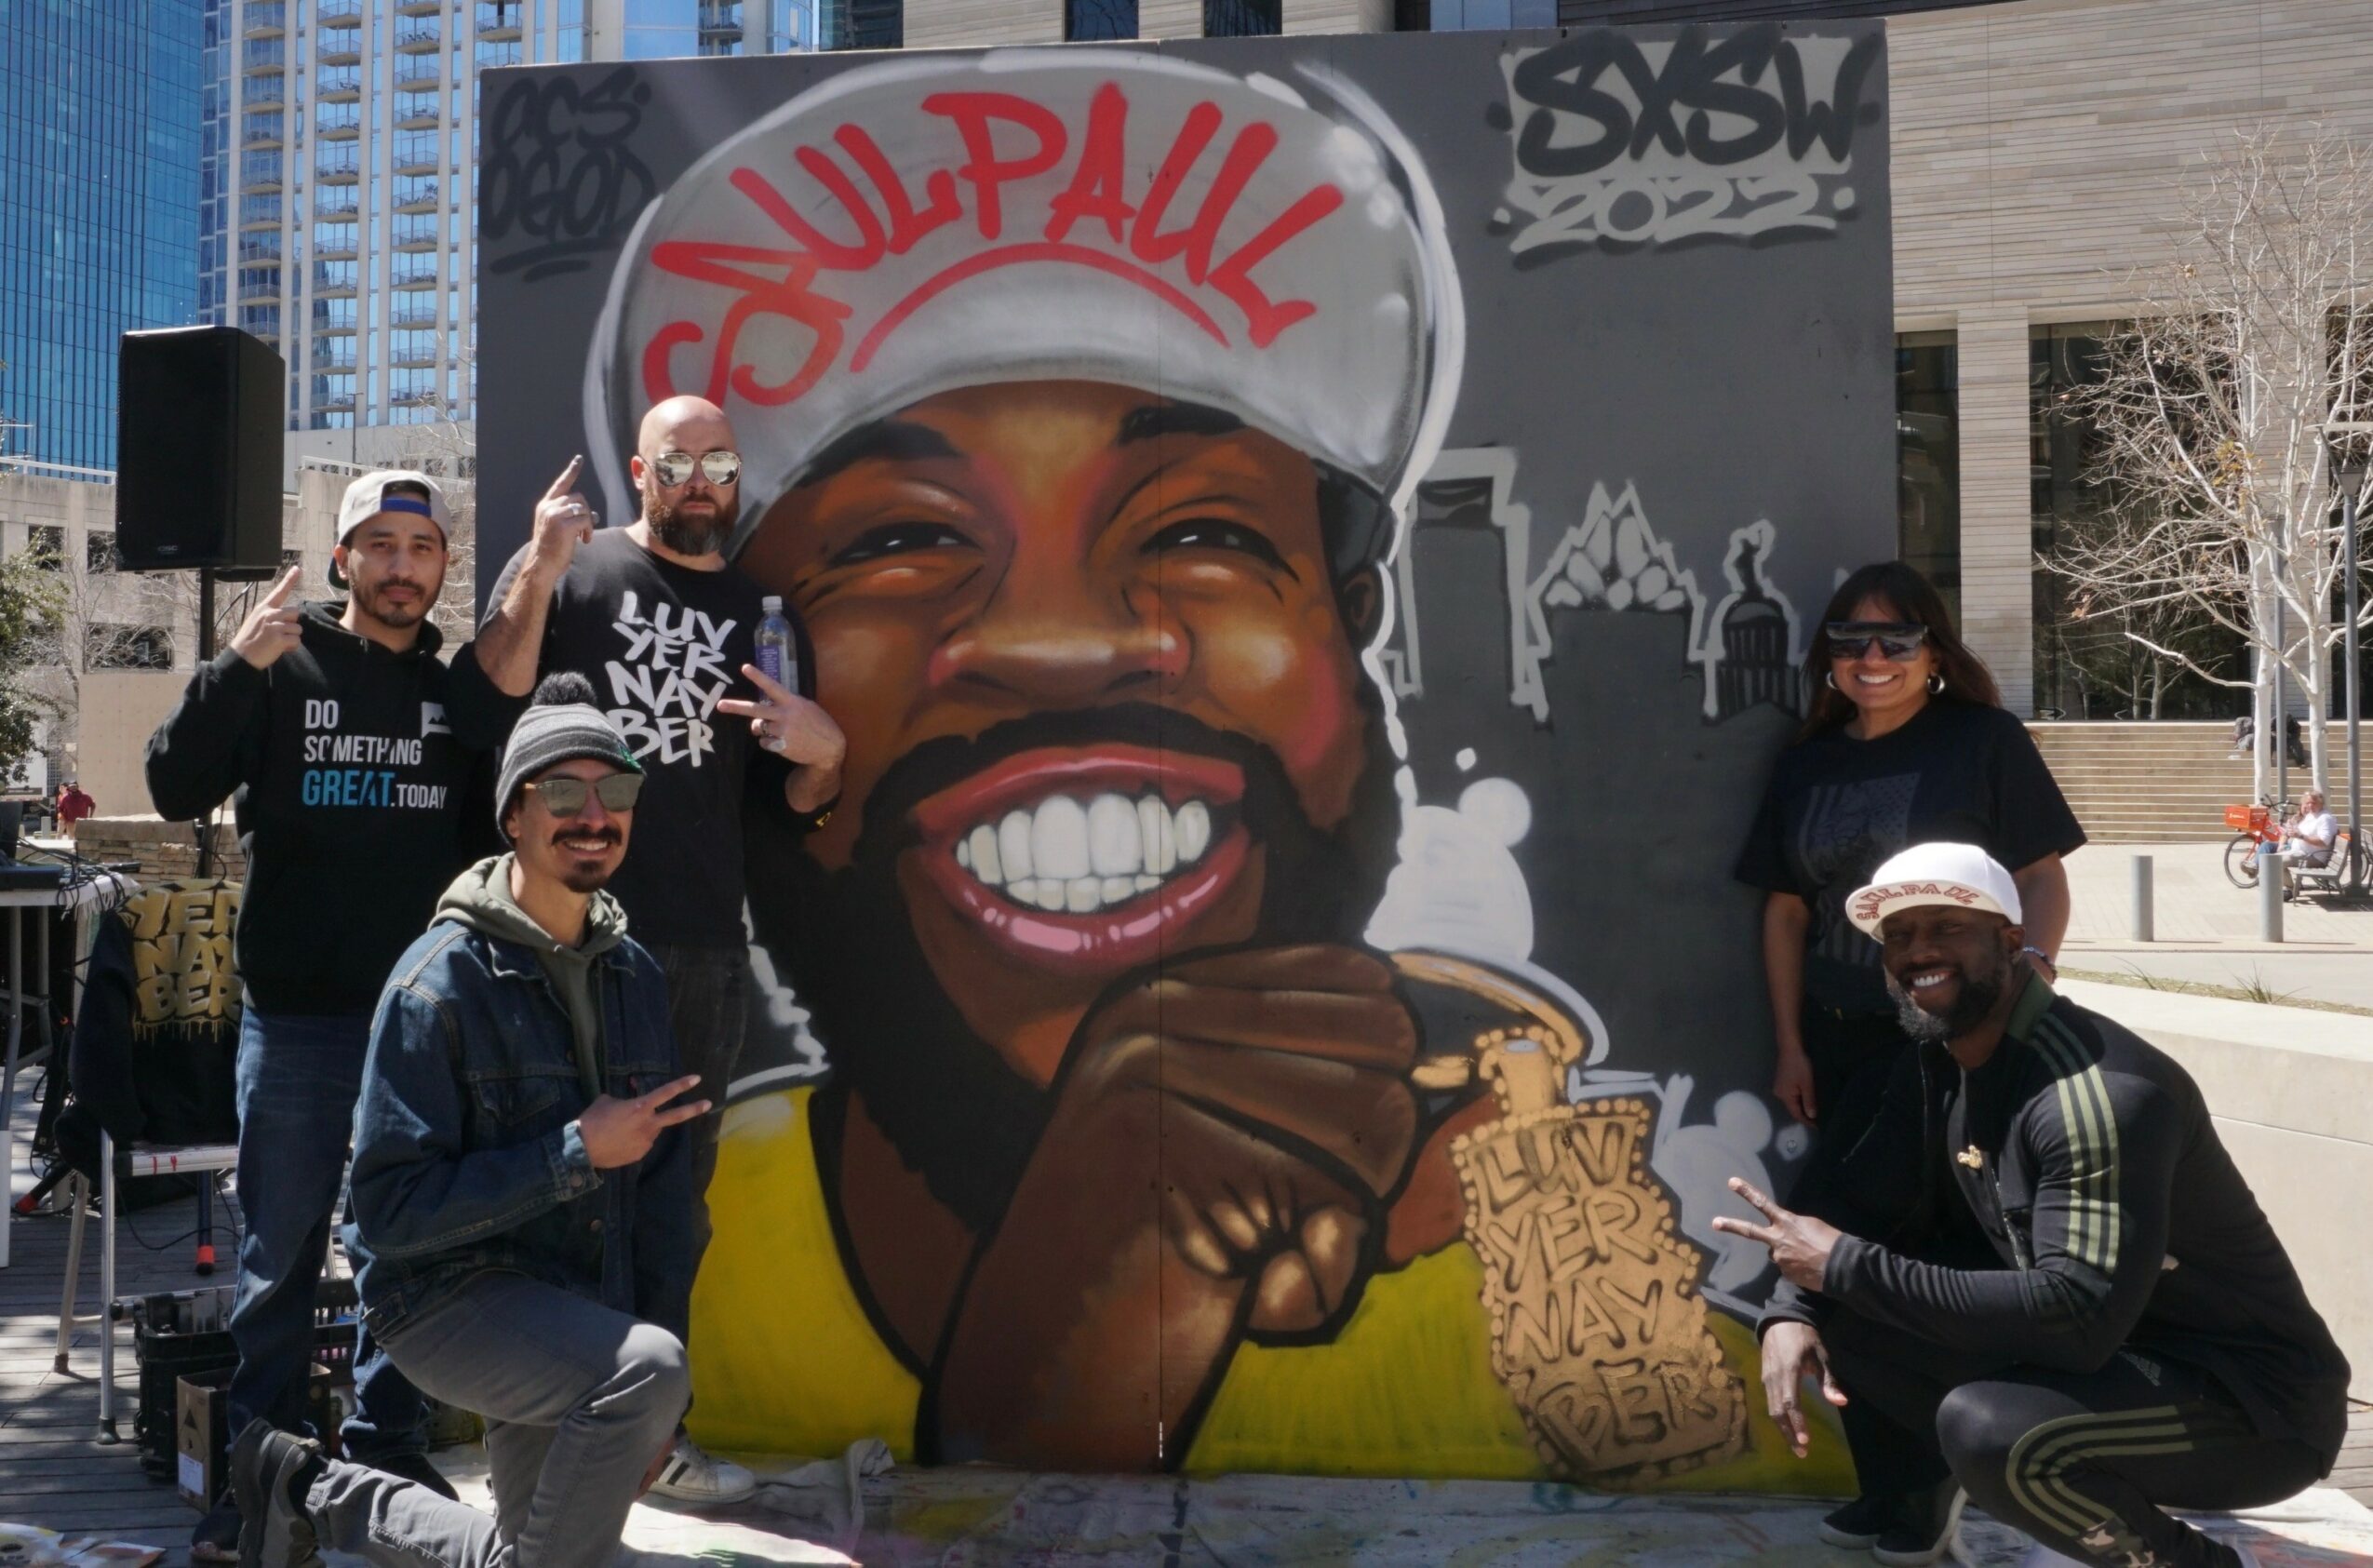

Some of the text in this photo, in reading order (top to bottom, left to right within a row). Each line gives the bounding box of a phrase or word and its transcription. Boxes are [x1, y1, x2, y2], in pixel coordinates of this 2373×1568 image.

[1512, 26, 1885, 177] SXSW
[1506, 175, 1838, 254] 2022
[611, 622, 733, 684] YER
[619, 590, 737, 650] LUV
[304, 699, 339, 730] DO
[605, 661, 727, 722] NAY
[303, 734, 422, 765] SOMETHING
[606, 708, 715, 768] BER
[1485, 1119, 1627, 1212] LUV
[1492, 1189, 1658, 1292] YER
[1502, 1279, 1663, 1365] NAY
[1535, 1358, 1717, 1463] BER
